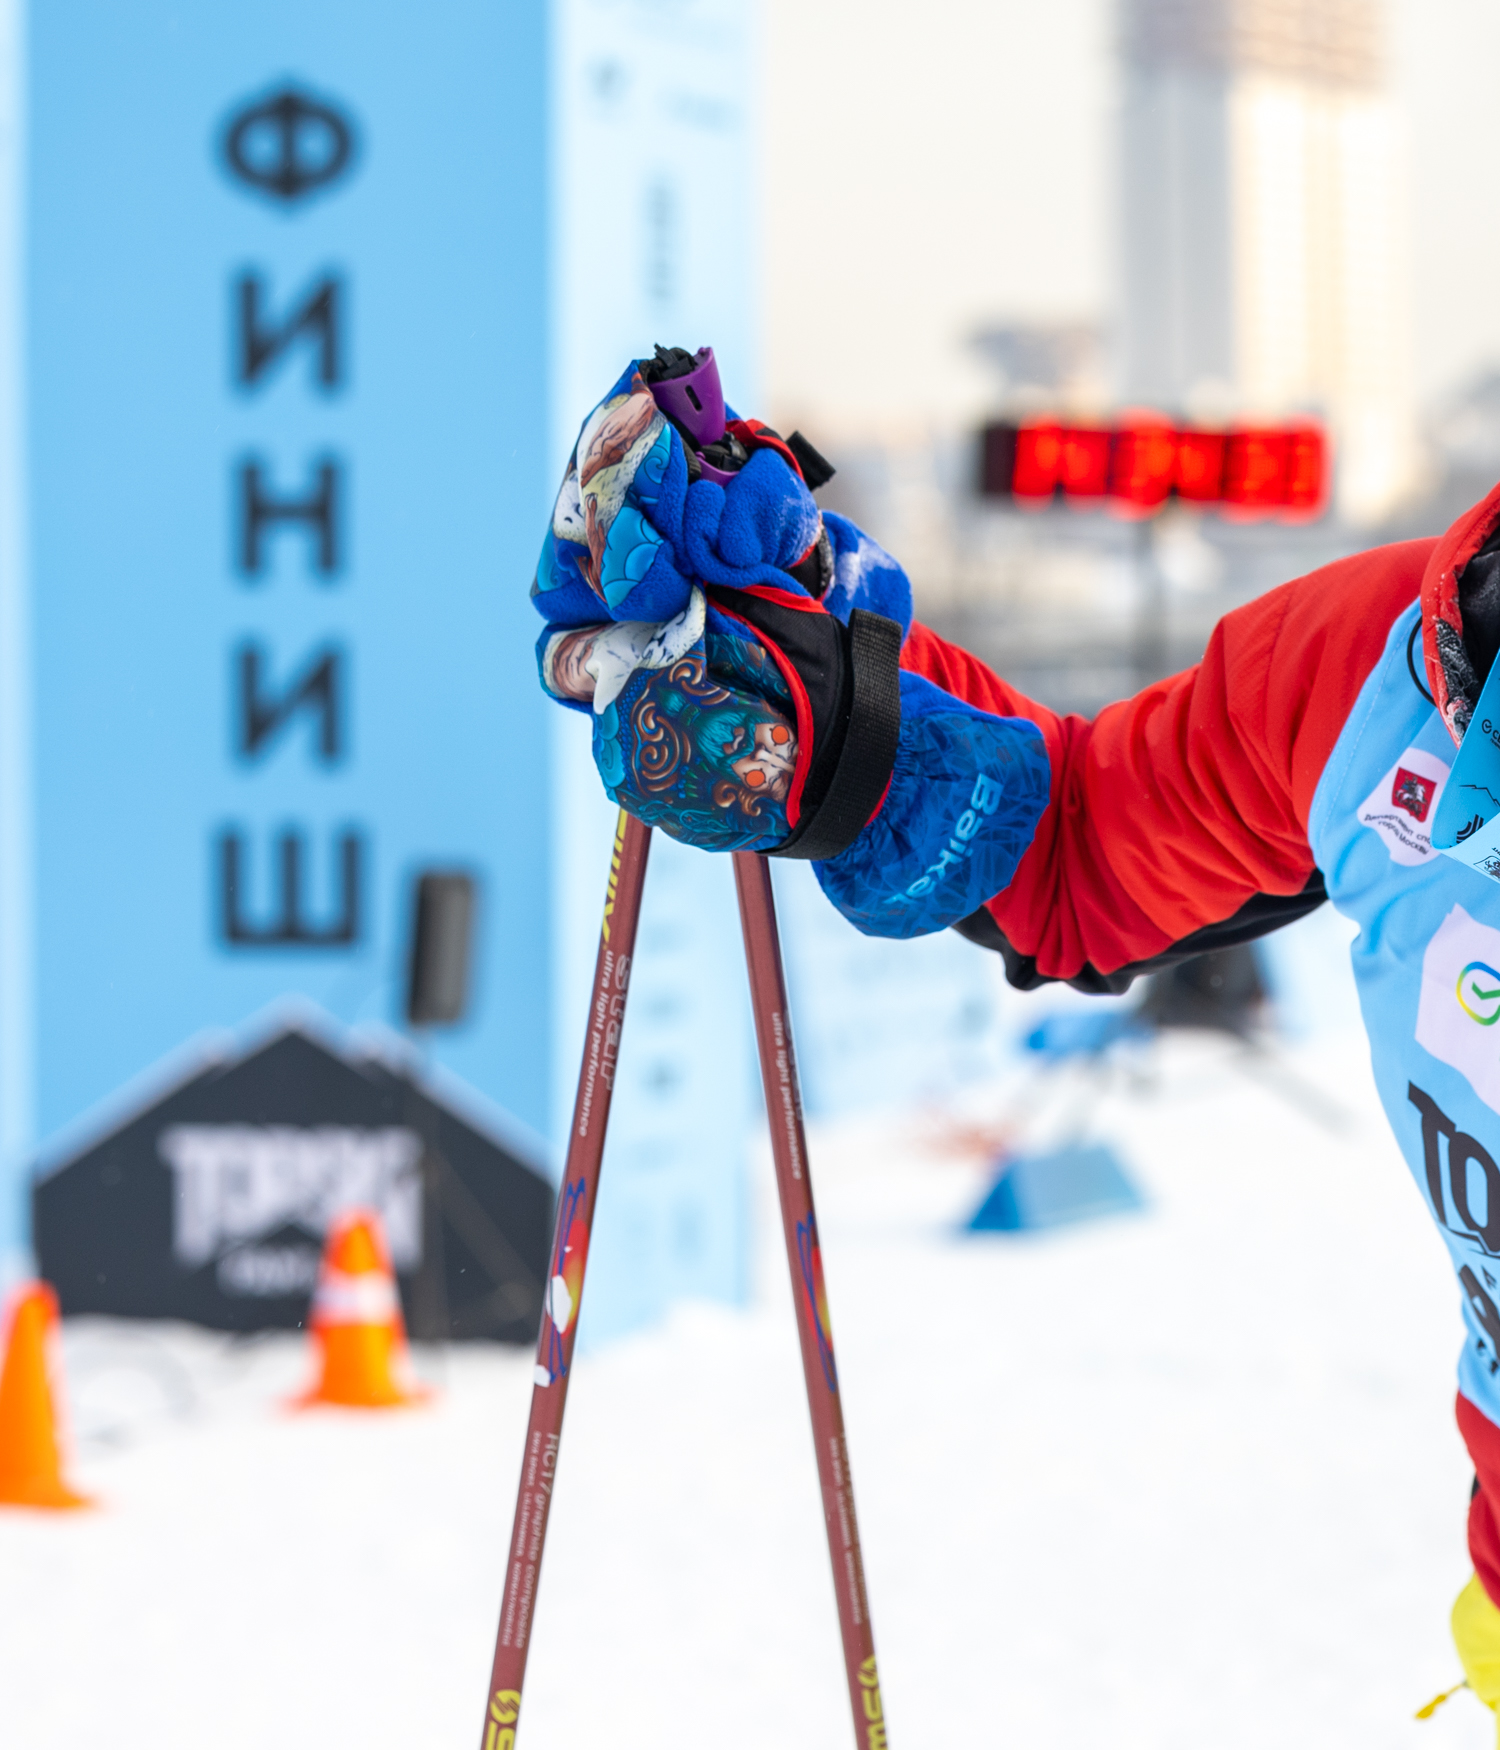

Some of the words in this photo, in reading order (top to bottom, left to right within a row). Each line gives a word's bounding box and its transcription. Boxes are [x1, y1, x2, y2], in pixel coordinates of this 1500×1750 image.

[216, 78, 360, 950] ФИНИШ
[600, 951, 615, 989] ultra
[596, 992, 610, 1029] light
[579, 1031, 601, 1138] performance
